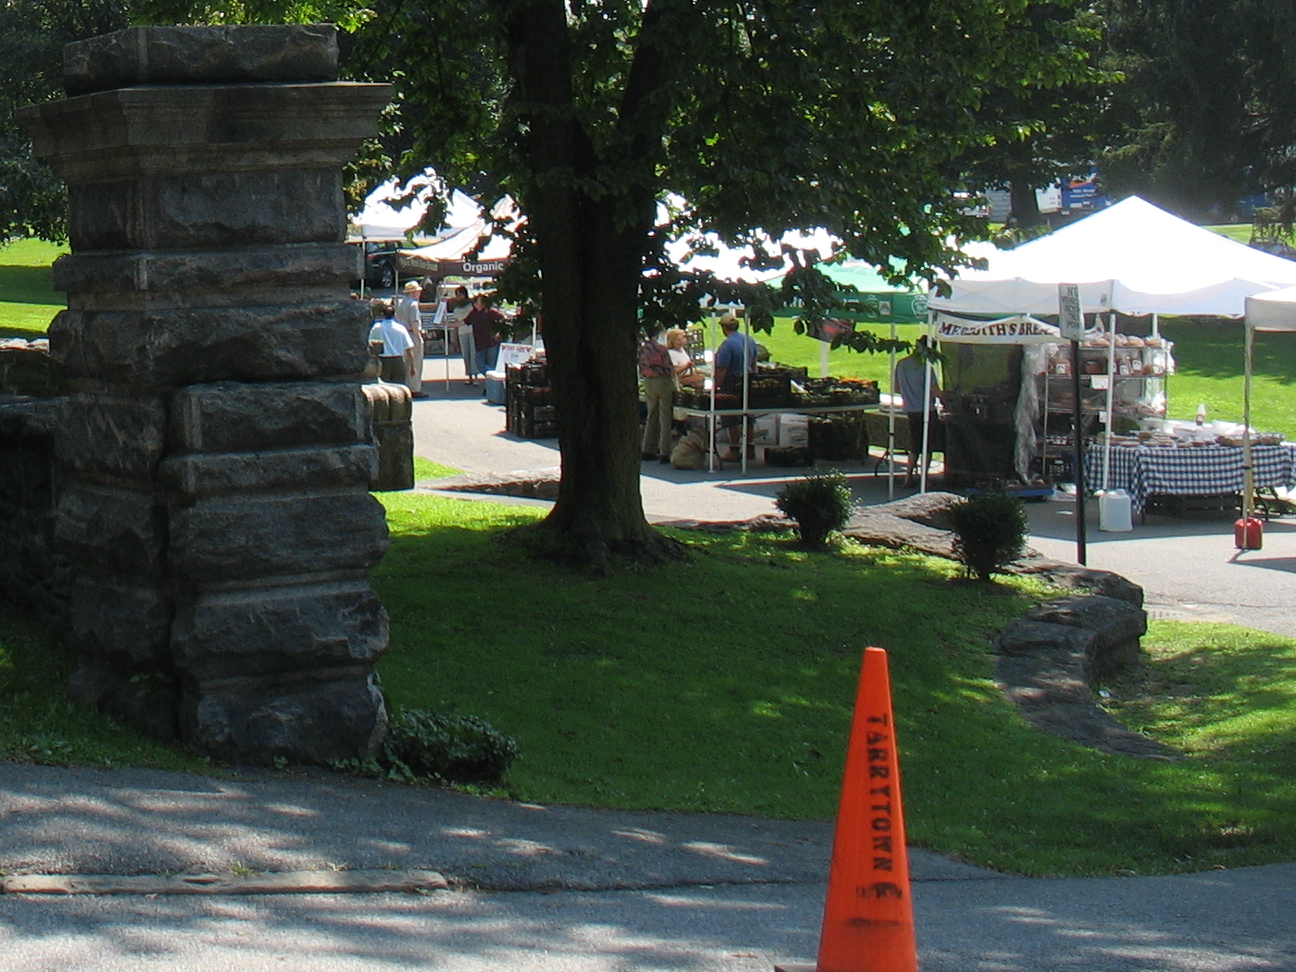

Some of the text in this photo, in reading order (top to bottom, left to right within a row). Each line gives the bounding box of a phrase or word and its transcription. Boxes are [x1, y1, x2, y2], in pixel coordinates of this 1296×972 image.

[462, 261, 505, 274] Organic
[1018, 322, 1053, 336] BRE
[864, 713, 894, 872] TARRYTOWN
